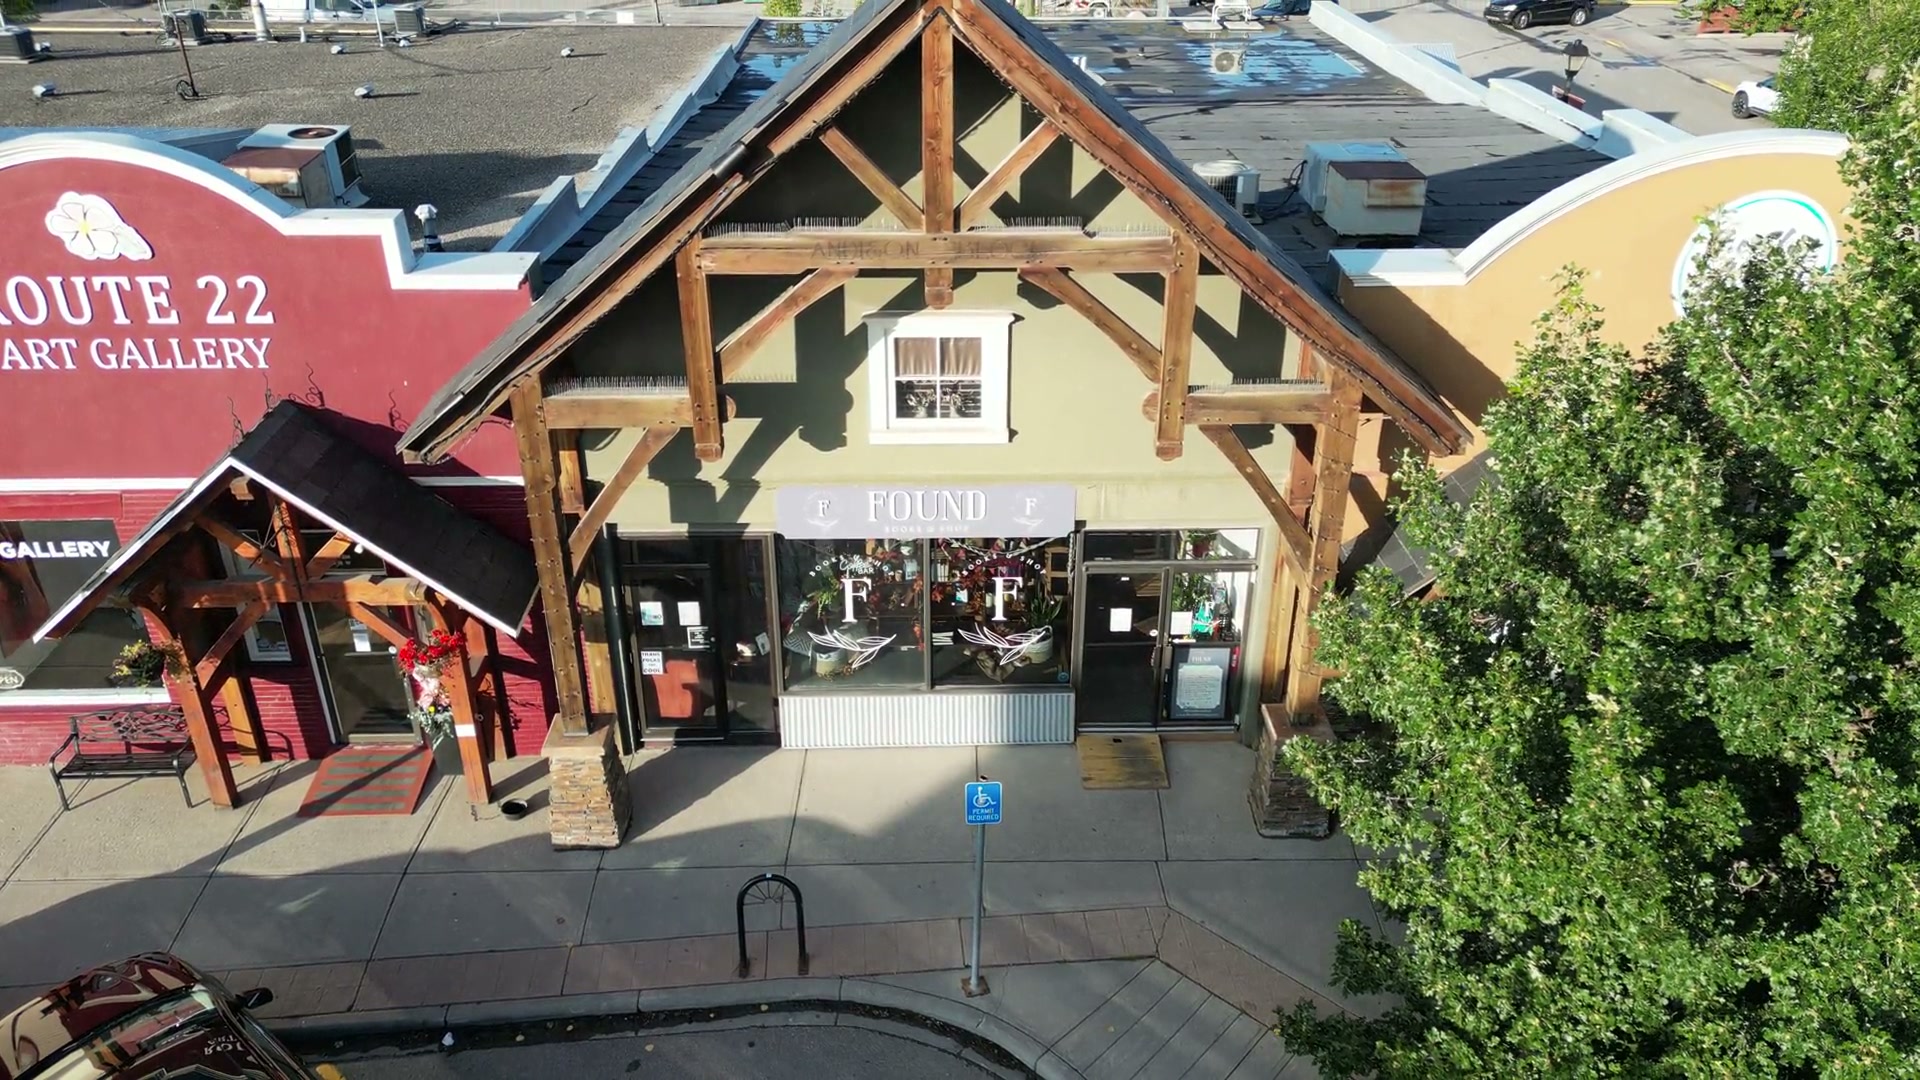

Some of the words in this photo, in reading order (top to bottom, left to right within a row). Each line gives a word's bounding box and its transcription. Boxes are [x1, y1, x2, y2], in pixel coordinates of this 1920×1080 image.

[0, 275, 180, 326] OUTE
[196, 275, 276, 325] 22
[1, 338, 78, 370] ART
[89, 338, 272, 370] GALLERY
[818, 499, 831, 518] F
[866, 489, 987, 522] FOUND
[1025, 497, 1038, 516] F
[0, 541, 110, 559] GALLERY
[840, 577, 872, 623] F
[991, 576, 1023, 621] F
[0, 675, 19, 684] PEN
